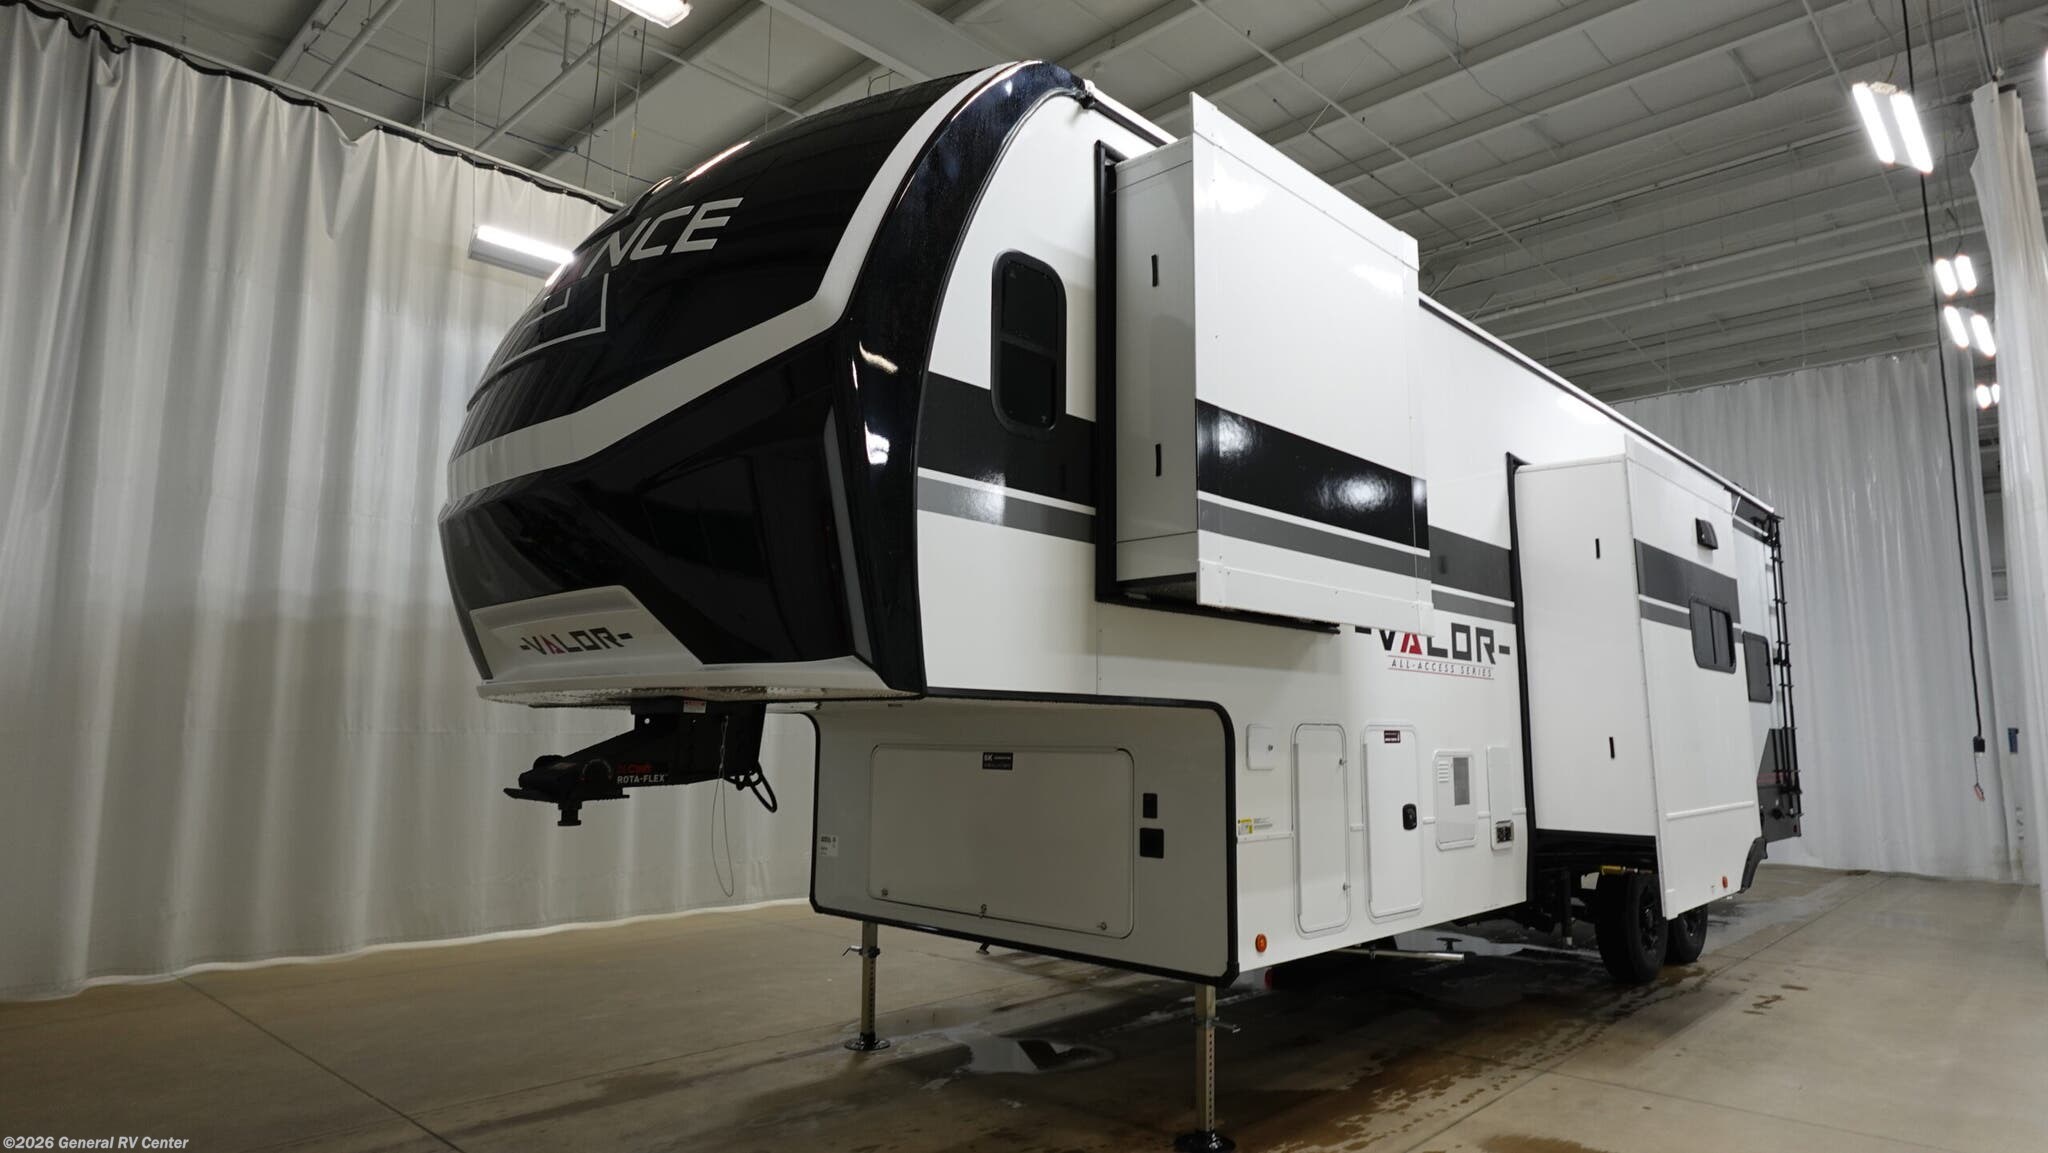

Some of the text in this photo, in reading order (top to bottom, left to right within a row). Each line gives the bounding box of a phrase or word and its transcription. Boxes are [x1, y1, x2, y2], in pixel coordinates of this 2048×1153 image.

[577, 197, 744, 279] NCE
[1391, 658, 1493, 678] ALL-ACCESS SERIES
[617, 774, 665, 784] ROTA-FLEX
